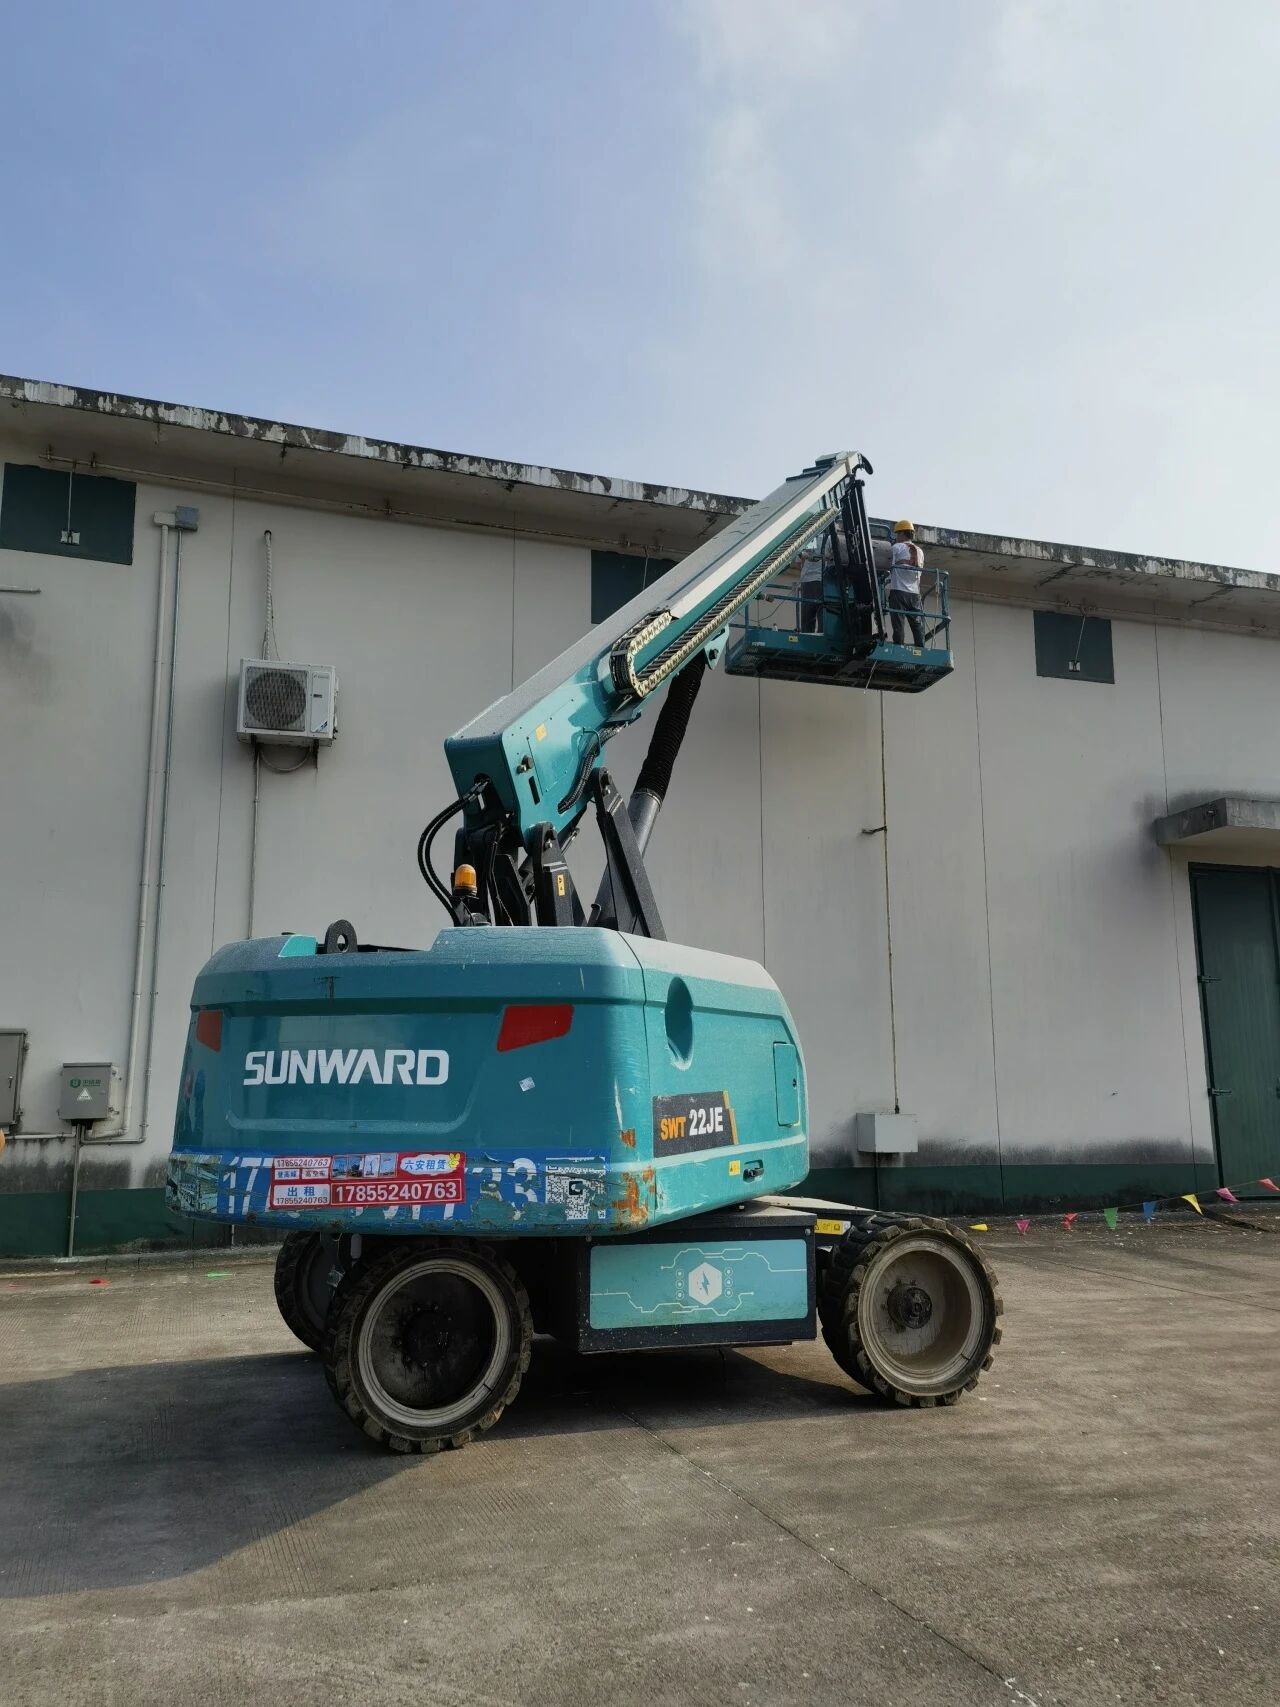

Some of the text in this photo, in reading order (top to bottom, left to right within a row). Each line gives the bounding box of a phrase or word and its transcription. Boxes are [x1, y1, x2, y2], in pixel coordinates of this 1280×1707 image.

[243, 1049, 449, 1086] SUNWARD
[660, 1106, 724, 1140] SWT 22JE
[276, 1158, 329, 1168] 17855240763
[404, 1159, 448, 1170] 六安租赁
[287, 1186, 315, 1197] 出租
[335, 1182, 457, 1202] 17855240763
